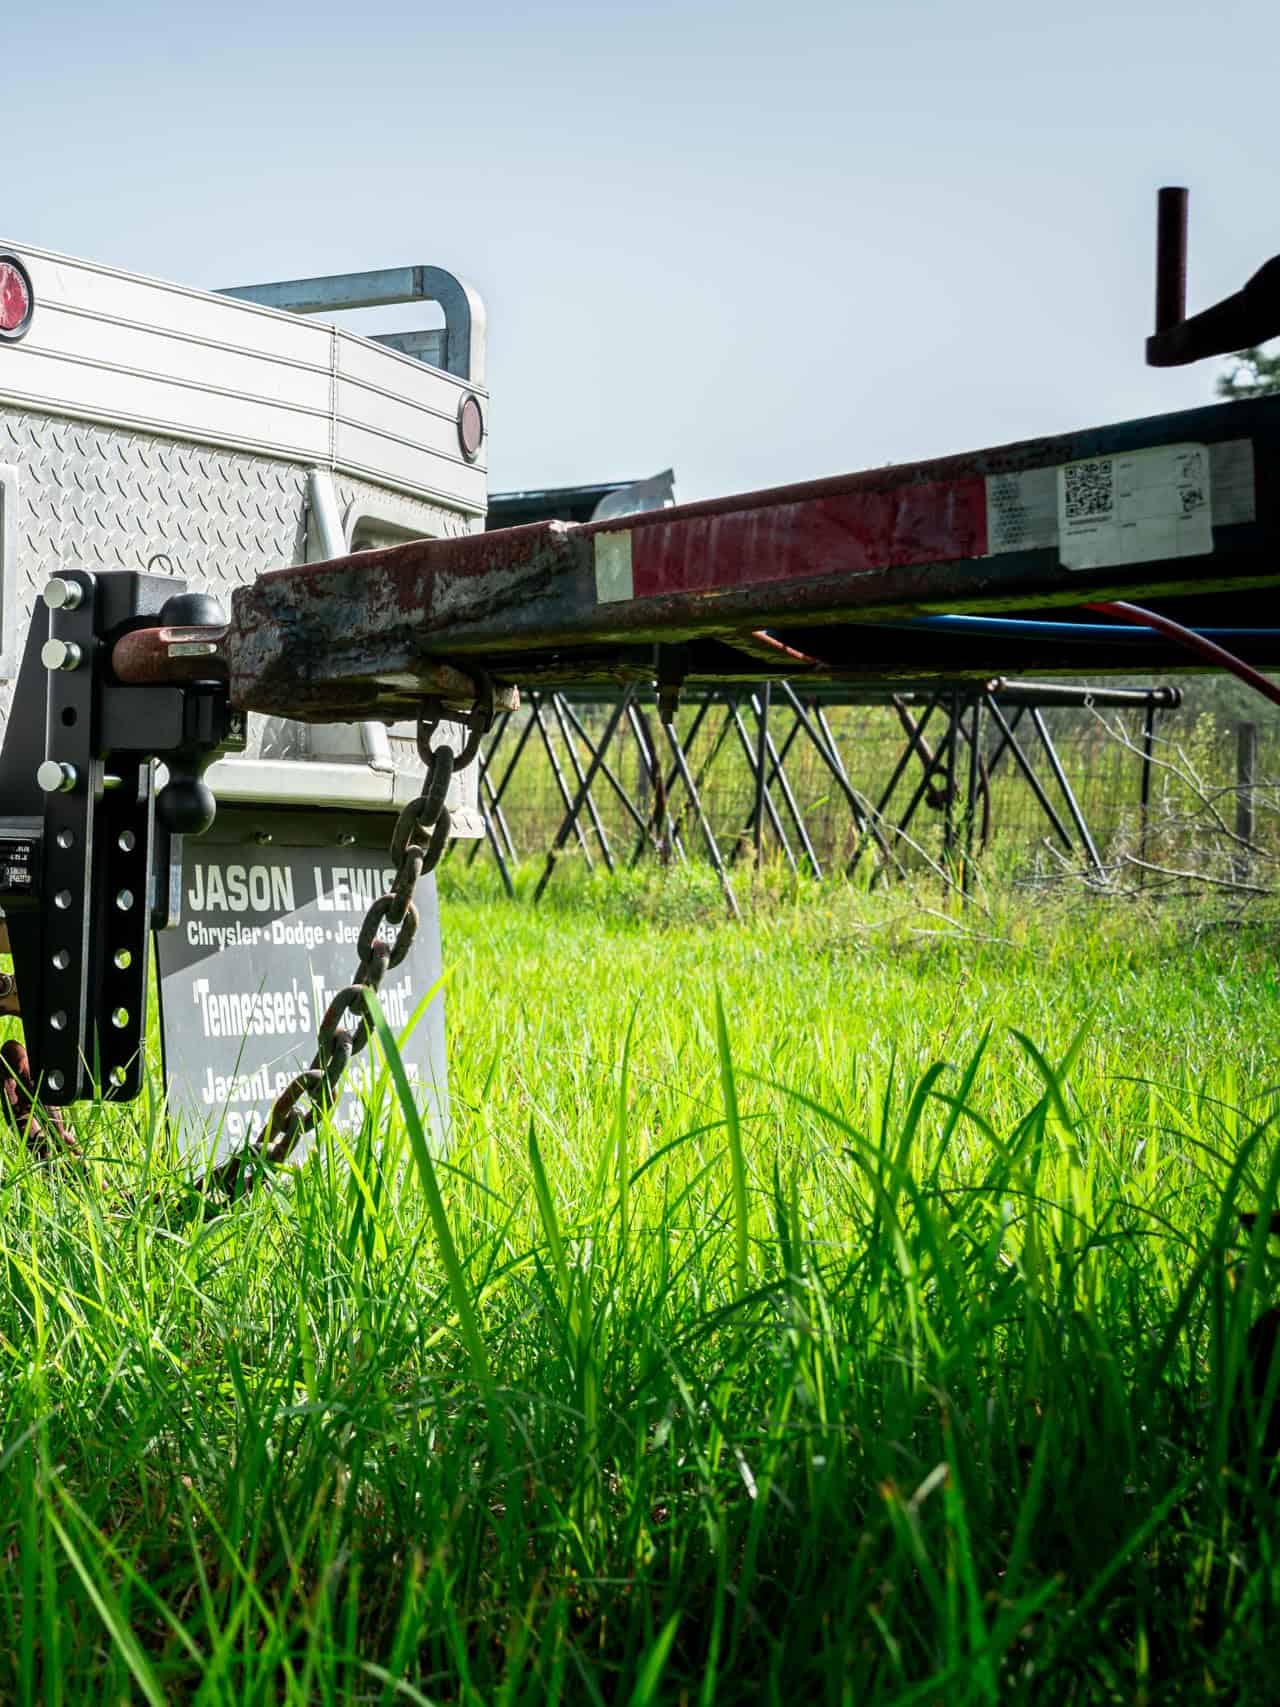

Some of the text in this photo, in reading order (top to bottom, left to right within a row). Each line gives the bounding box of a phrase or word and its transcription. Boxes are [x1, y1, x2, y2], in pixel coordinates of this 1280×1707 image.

[188, 864, 295, 912] JASON
[187, 921, 261, 953] Chrysler
[271, 921, 323, 949] Dodge
[335, 921, 360, 944] Jee
